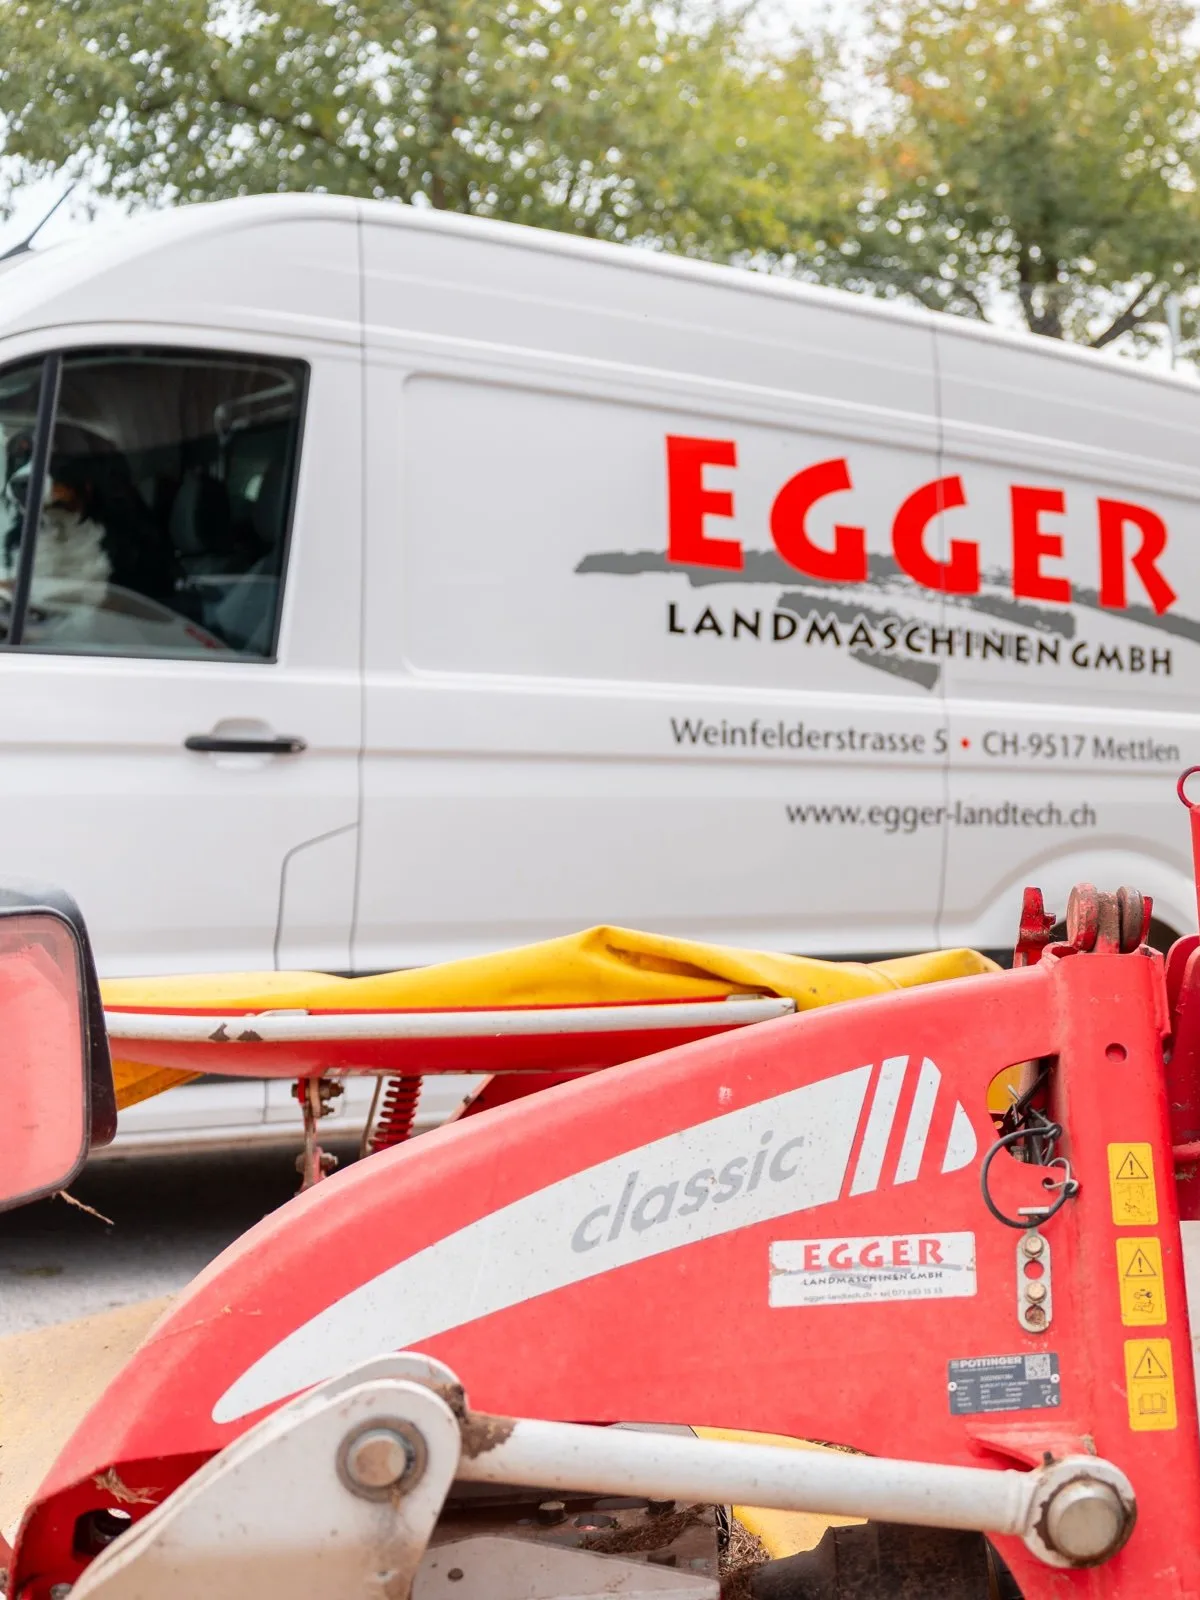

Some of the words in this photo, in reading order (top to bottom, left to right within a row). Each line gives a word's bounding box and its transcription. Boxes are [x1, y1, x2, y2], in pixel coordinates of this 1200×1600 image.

[665, 434, 1177, 616] EGGER
[668, 602, 1061, 665] LANDMASCHINEN
[1070, 639, 1174, 675] GMBH
[670, 716, 926, 753] Weinfelderstrasse
[933, 728, 949, 754] 5
[982, 730, 1086, 760] CH-9517
[1092, 735, 1181, 762] Mettlen
[785, 799, 1097, 834] www.egger-landtech.ch
[570, 1130, 805, 1254] classic
[803, 1239, 944, 1272] EGGER
